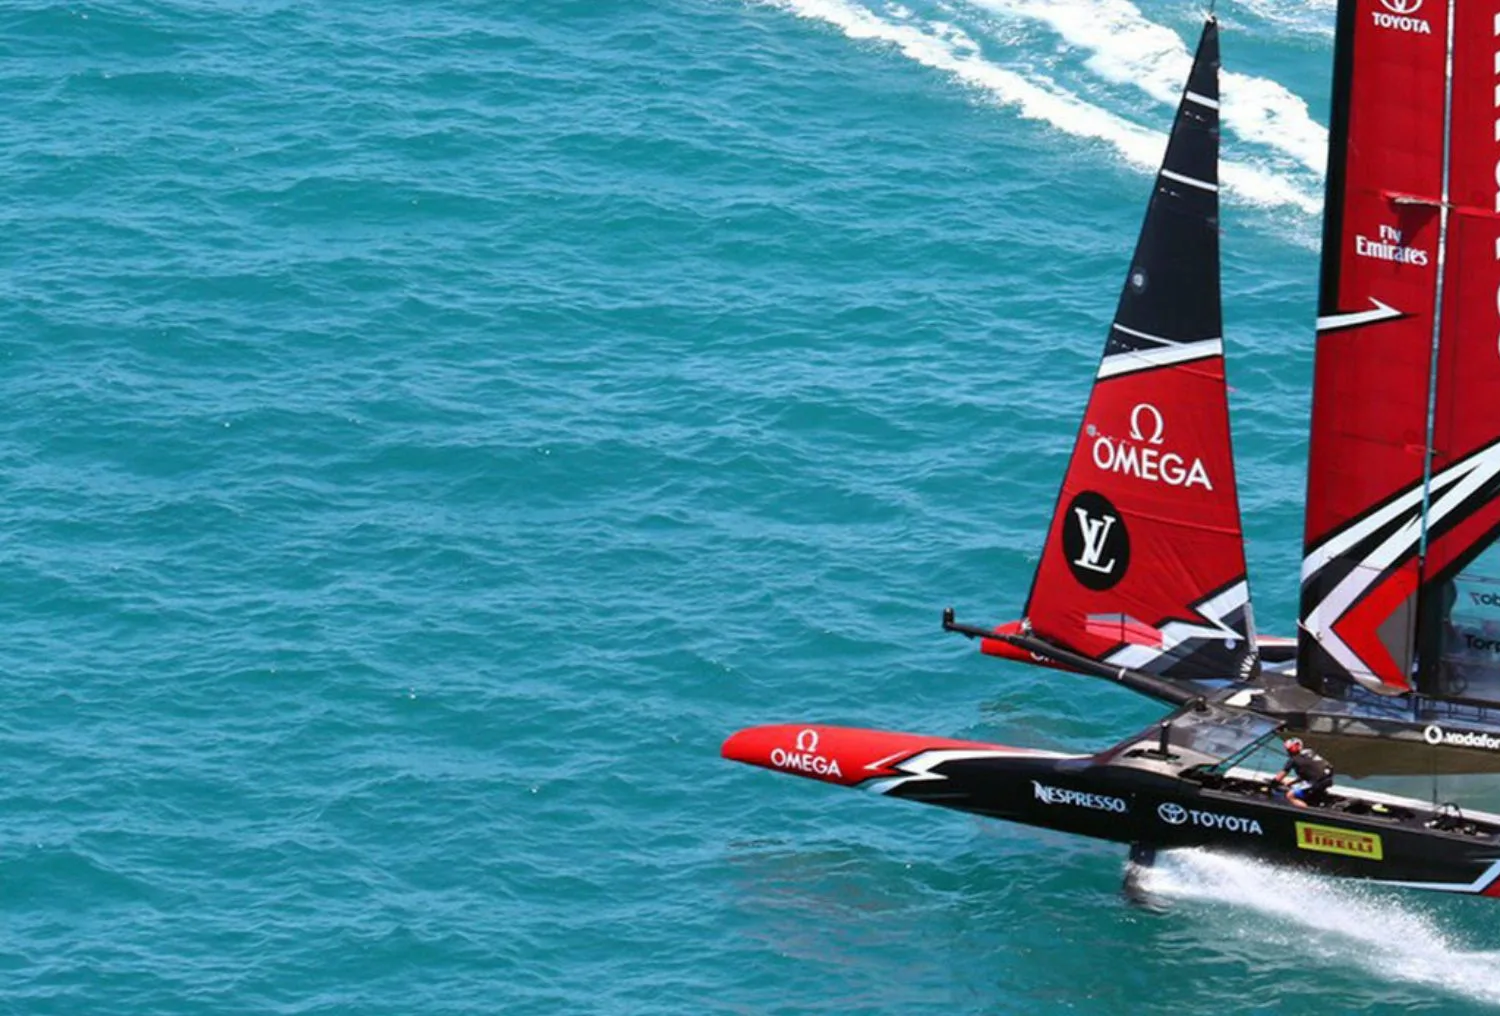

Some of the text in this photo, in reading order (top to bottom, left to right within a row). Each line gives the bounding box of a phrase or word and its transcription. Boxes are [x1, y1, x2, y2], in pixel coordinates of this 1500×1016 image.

[1371, 11, 1432, 34] TOYOTA
[1355, 224, 1429, 266] Fly Emirates
[1092, 436, 1213, 491] OMEGA
[770, 747, 843, 778] OMEGA
[1031, 780, 1127, 813] NESPRESSO
[1189, 809, 1264, 835] TOYOTA
[1303, 826, 1375, 853] PIRELLI
